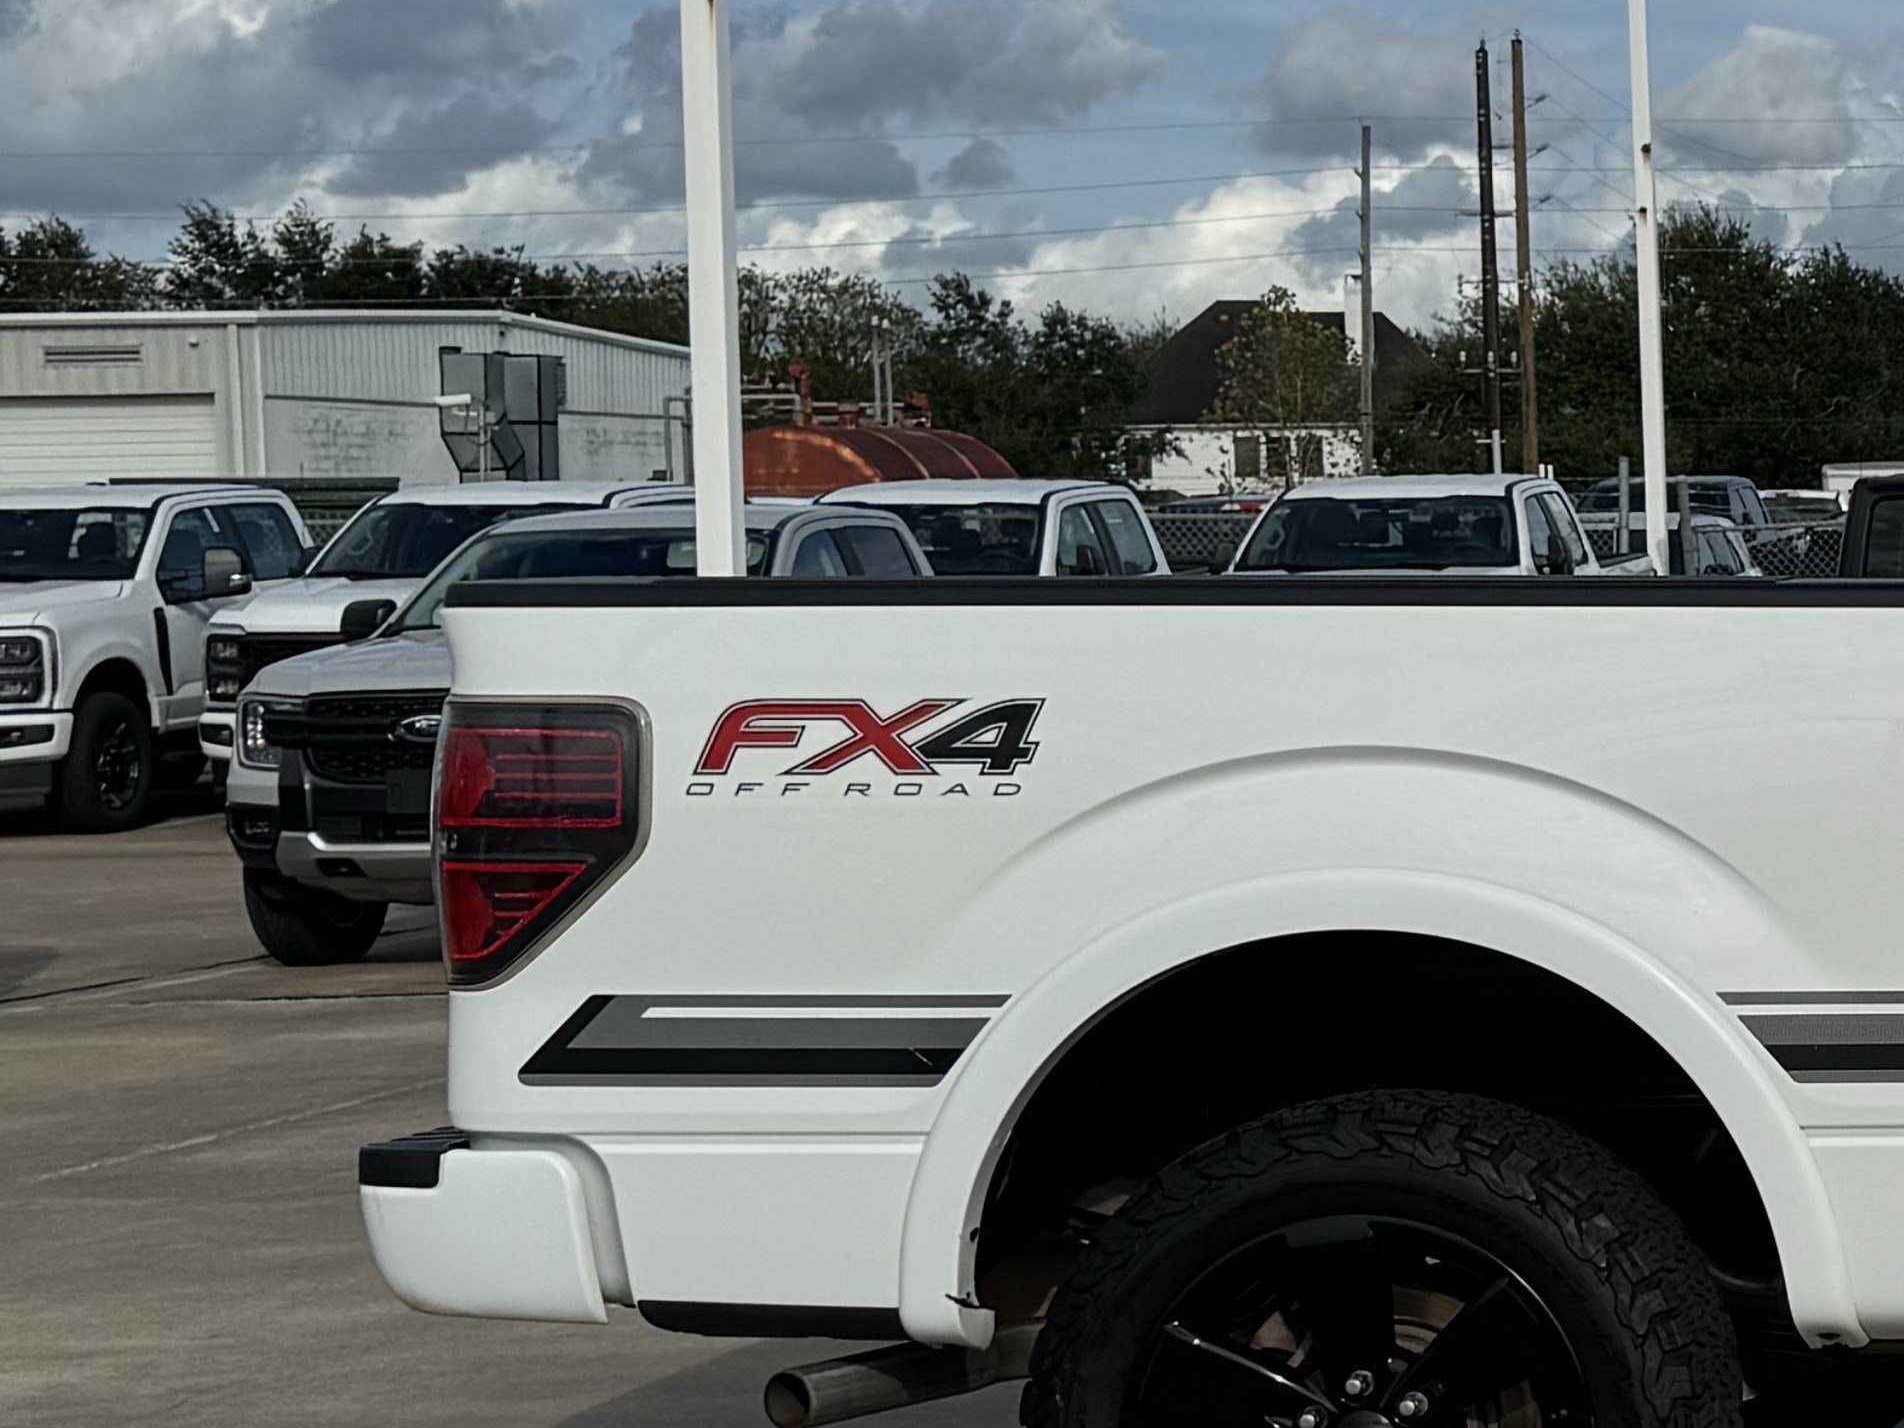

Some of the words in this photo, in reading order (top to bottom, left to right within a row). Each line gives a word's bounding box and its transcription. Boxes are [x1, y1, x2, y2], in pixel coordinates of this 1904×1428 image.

[693, 697, 1046, 776] FX4
[685, 782, 810, 797] OFF
[843, 782, 1023, 797] ROAD
